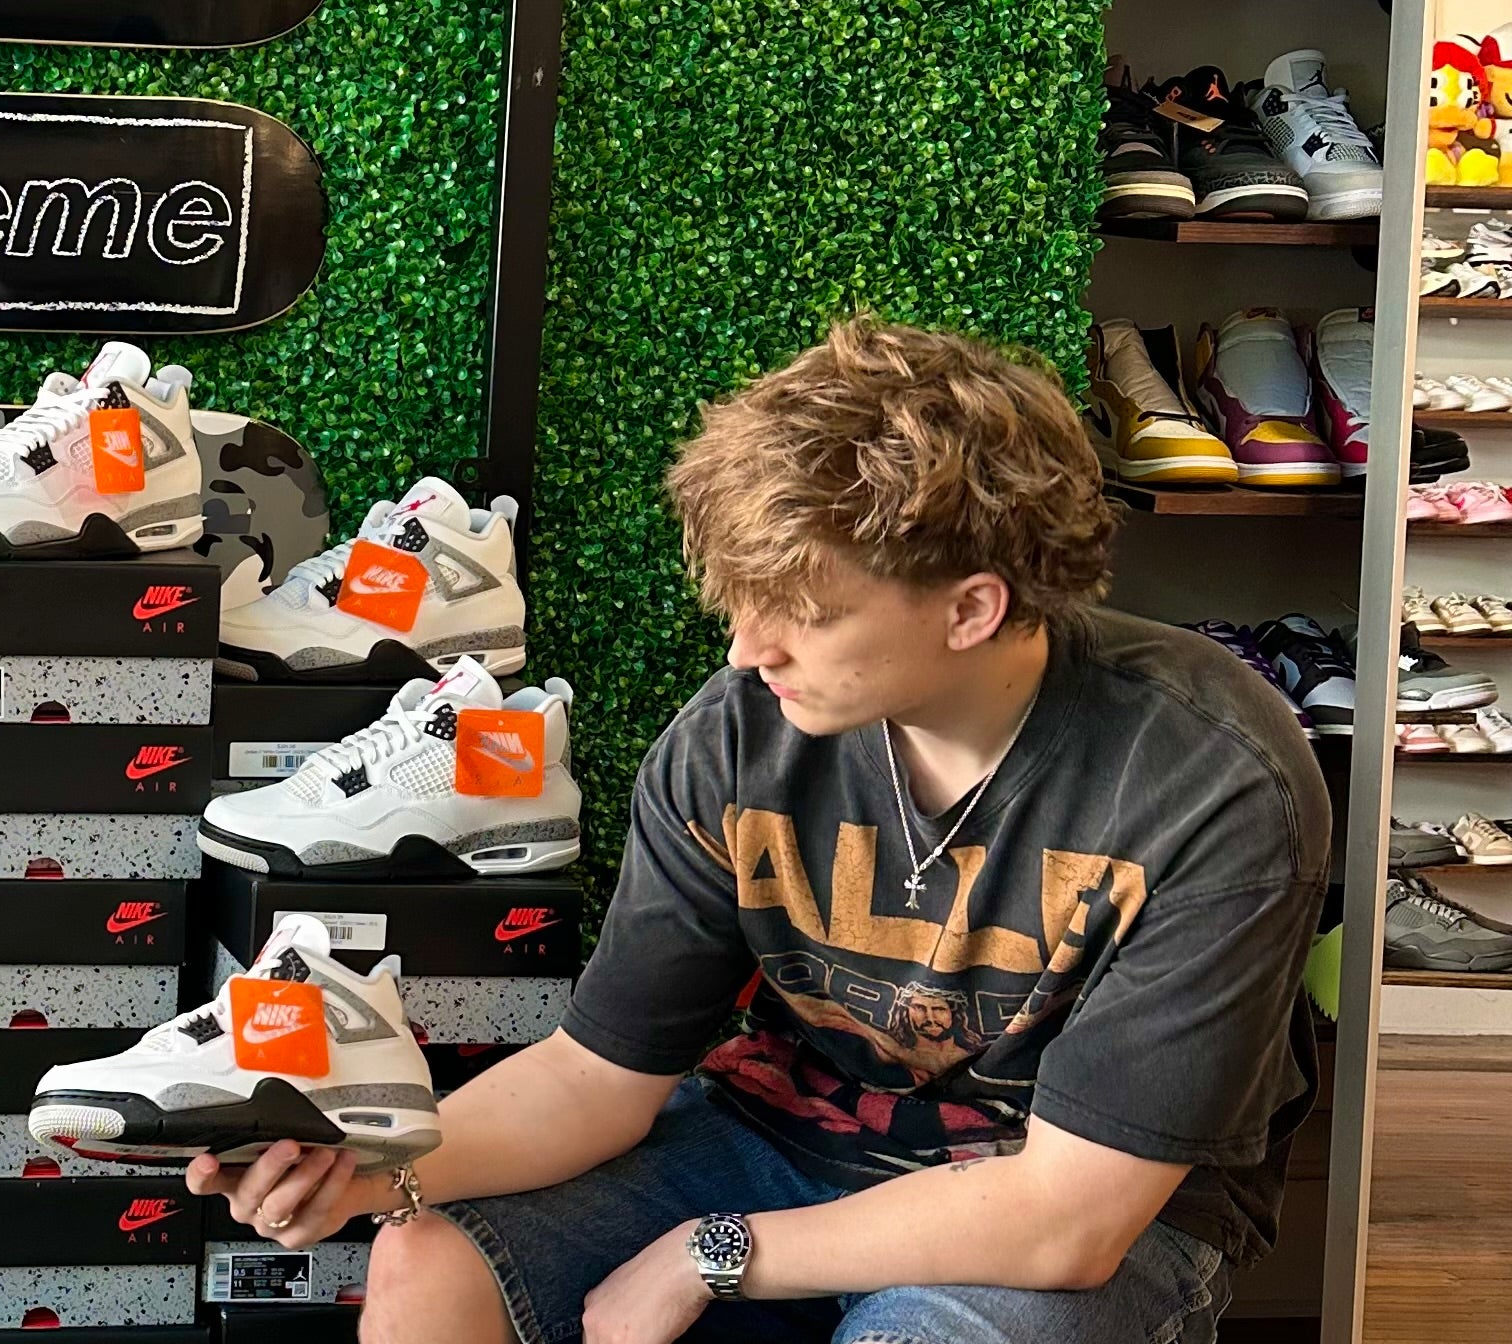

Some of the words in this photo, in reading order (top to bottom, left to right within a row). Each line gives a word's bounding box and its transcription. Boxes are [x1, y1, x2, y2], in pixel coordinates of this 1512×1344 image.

[143, 586, 187, 606] NIKE
[142, 622, 186, 633] AIR
[135, 746, 180, 765] NIKE
[135, 782, 178, 793] AIR
[115, 902, 157, 920] NIKE
[506, 908, 549, 927] NIKE
[114, 935, 156, 945] AIR
[503, 944, 547, 955] AIR
[252, 1002, 304, 1027] NIKE
[128, 1199, 170, 1218] NIKE
[127, 1233, 169, 1244] AIR
